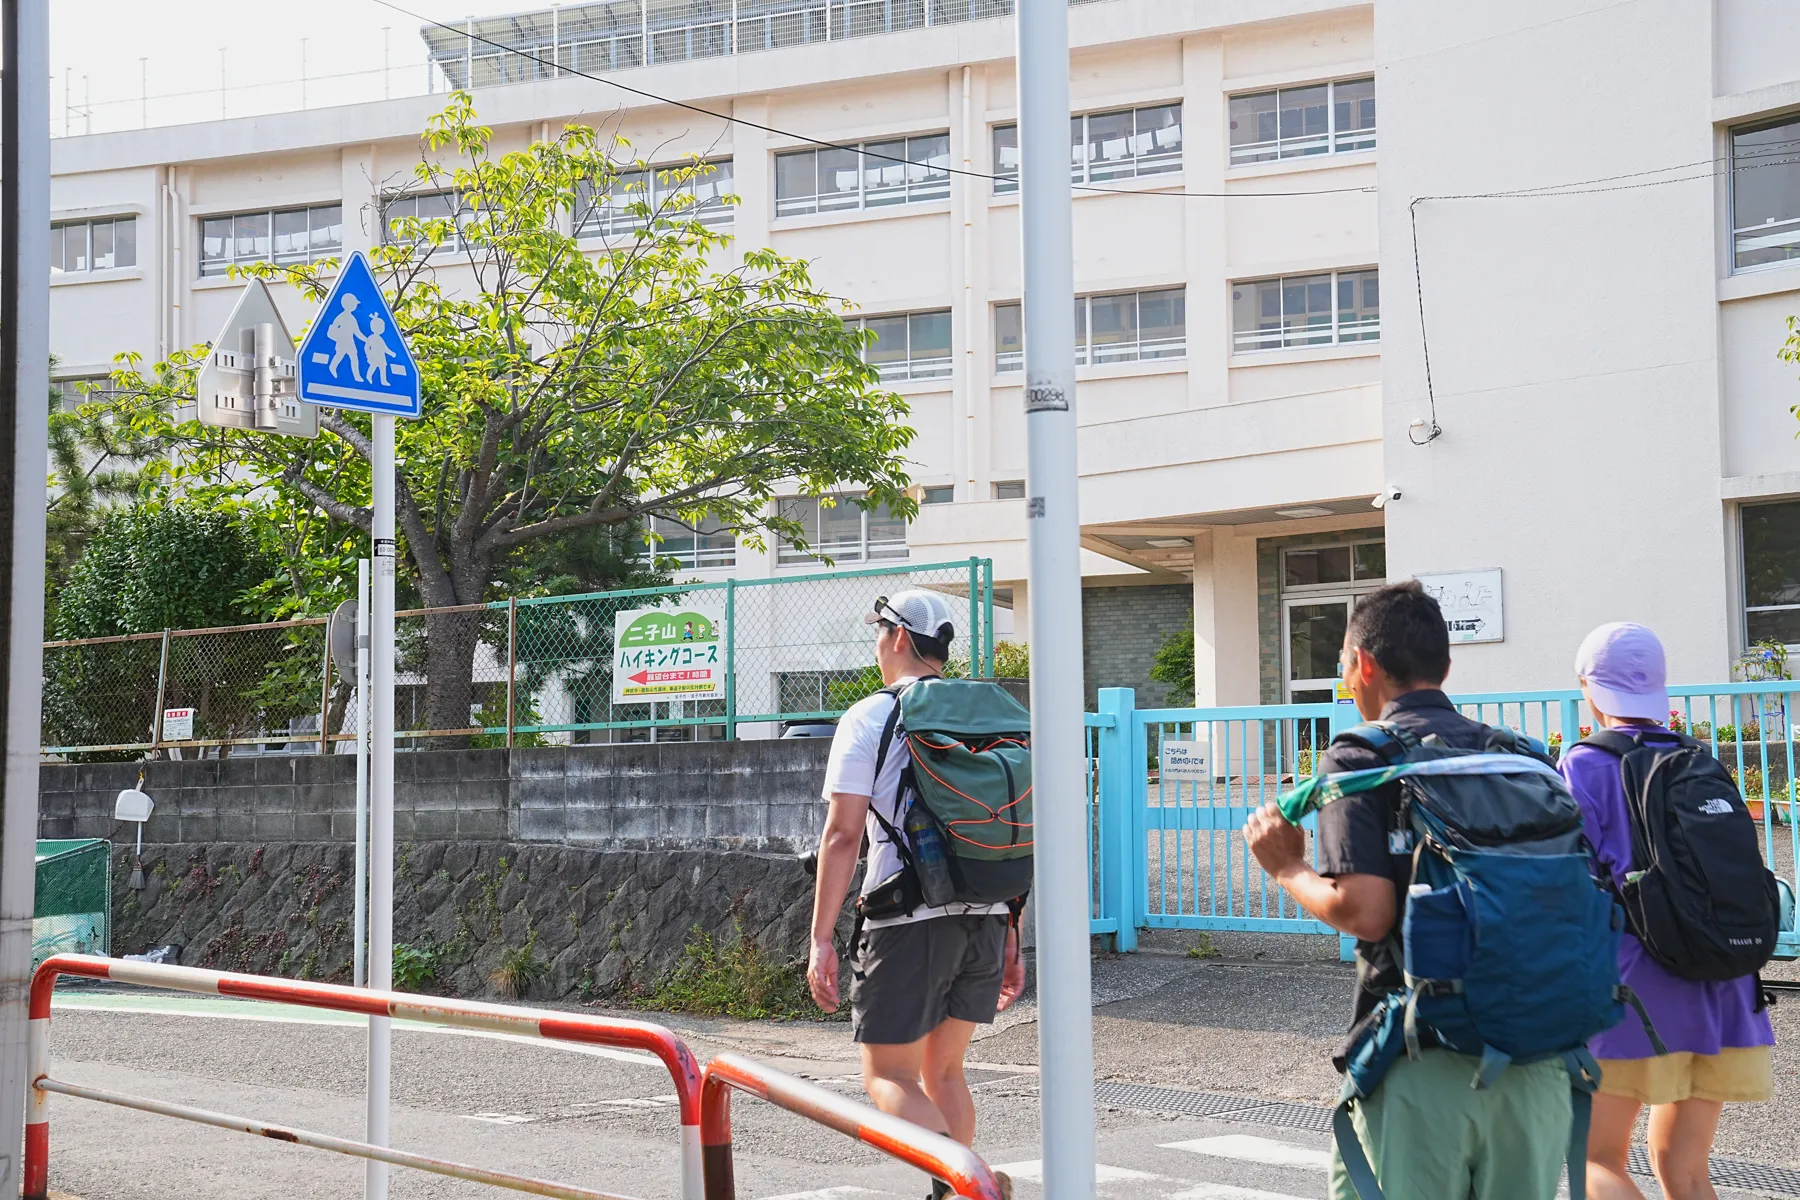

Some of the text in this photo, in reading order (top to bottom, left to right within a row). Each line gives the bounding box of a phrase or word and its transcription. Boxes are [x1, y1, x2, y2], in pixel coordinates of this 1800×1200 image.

[628, 623, 677, 642] 二子山
[620, 645, 718, 669] ハイキングコース
[1165, 747, 1188, 755] こちらは
